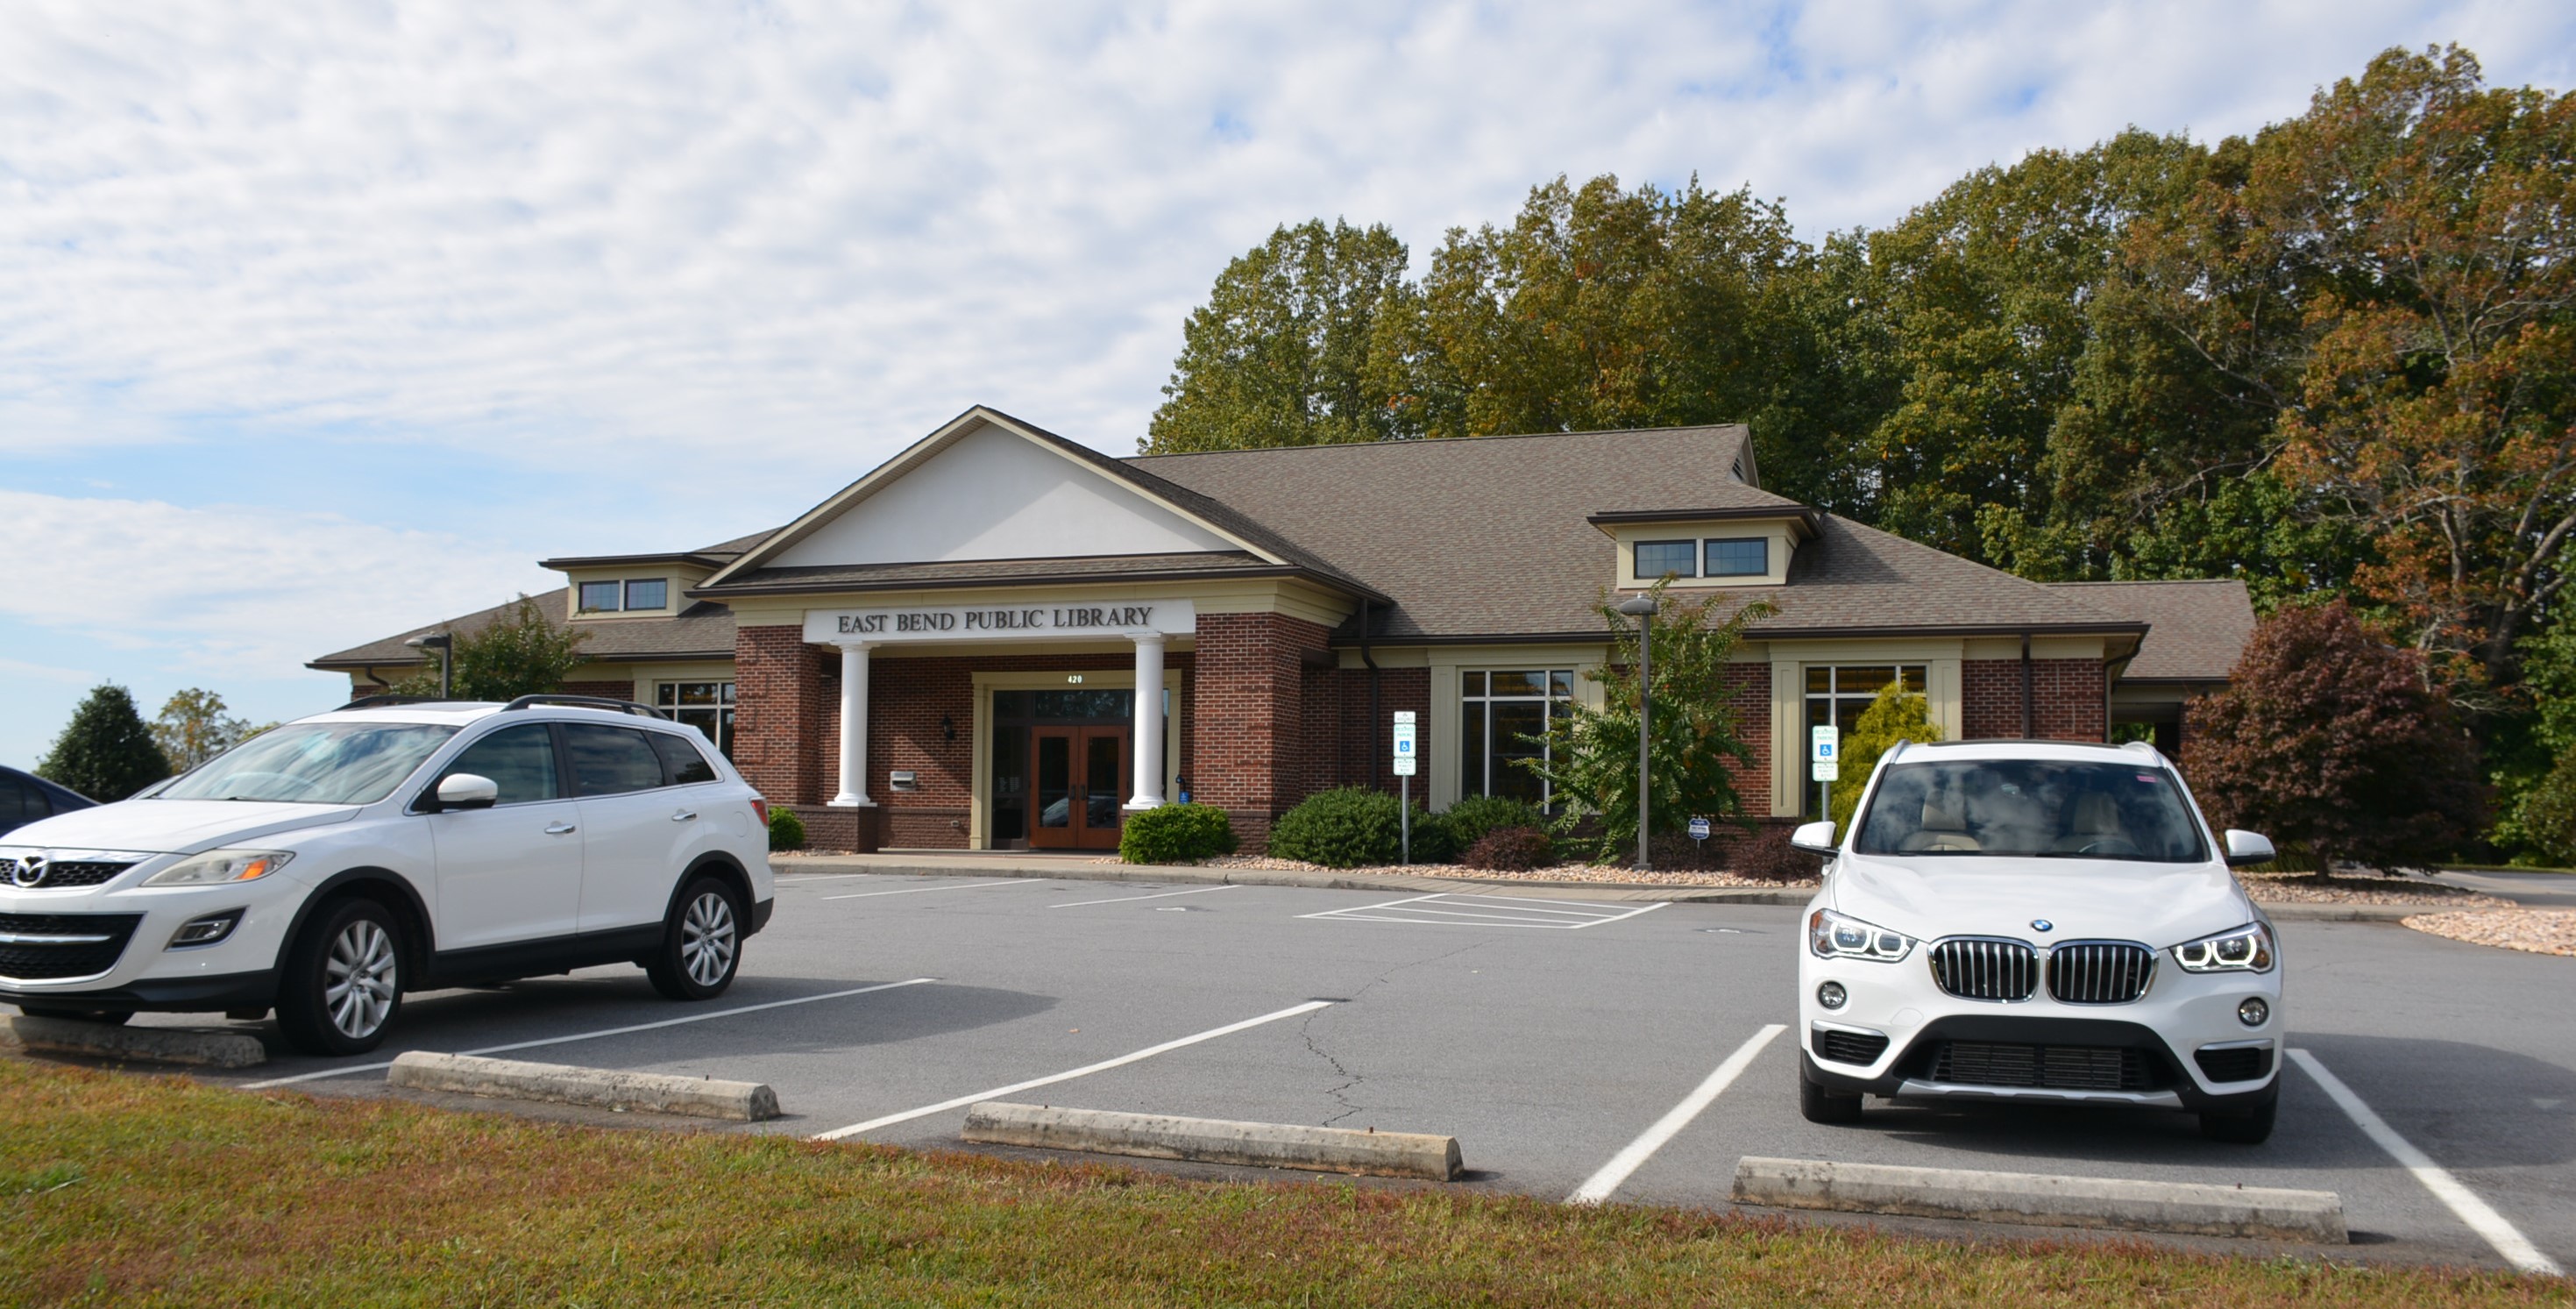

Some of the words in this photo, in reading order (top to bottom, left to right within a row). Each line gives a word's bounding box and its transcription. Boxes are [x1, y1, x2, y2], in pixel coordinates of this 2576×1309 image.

[837, 615, 888, 633] EAST
[896, 613, 954, 631] BEND
[964, 609, 1044, 630] PUBLIC
[1053, 607, 1153, 627] LIBRARY
[1068, 675, 1082, 684] 420
